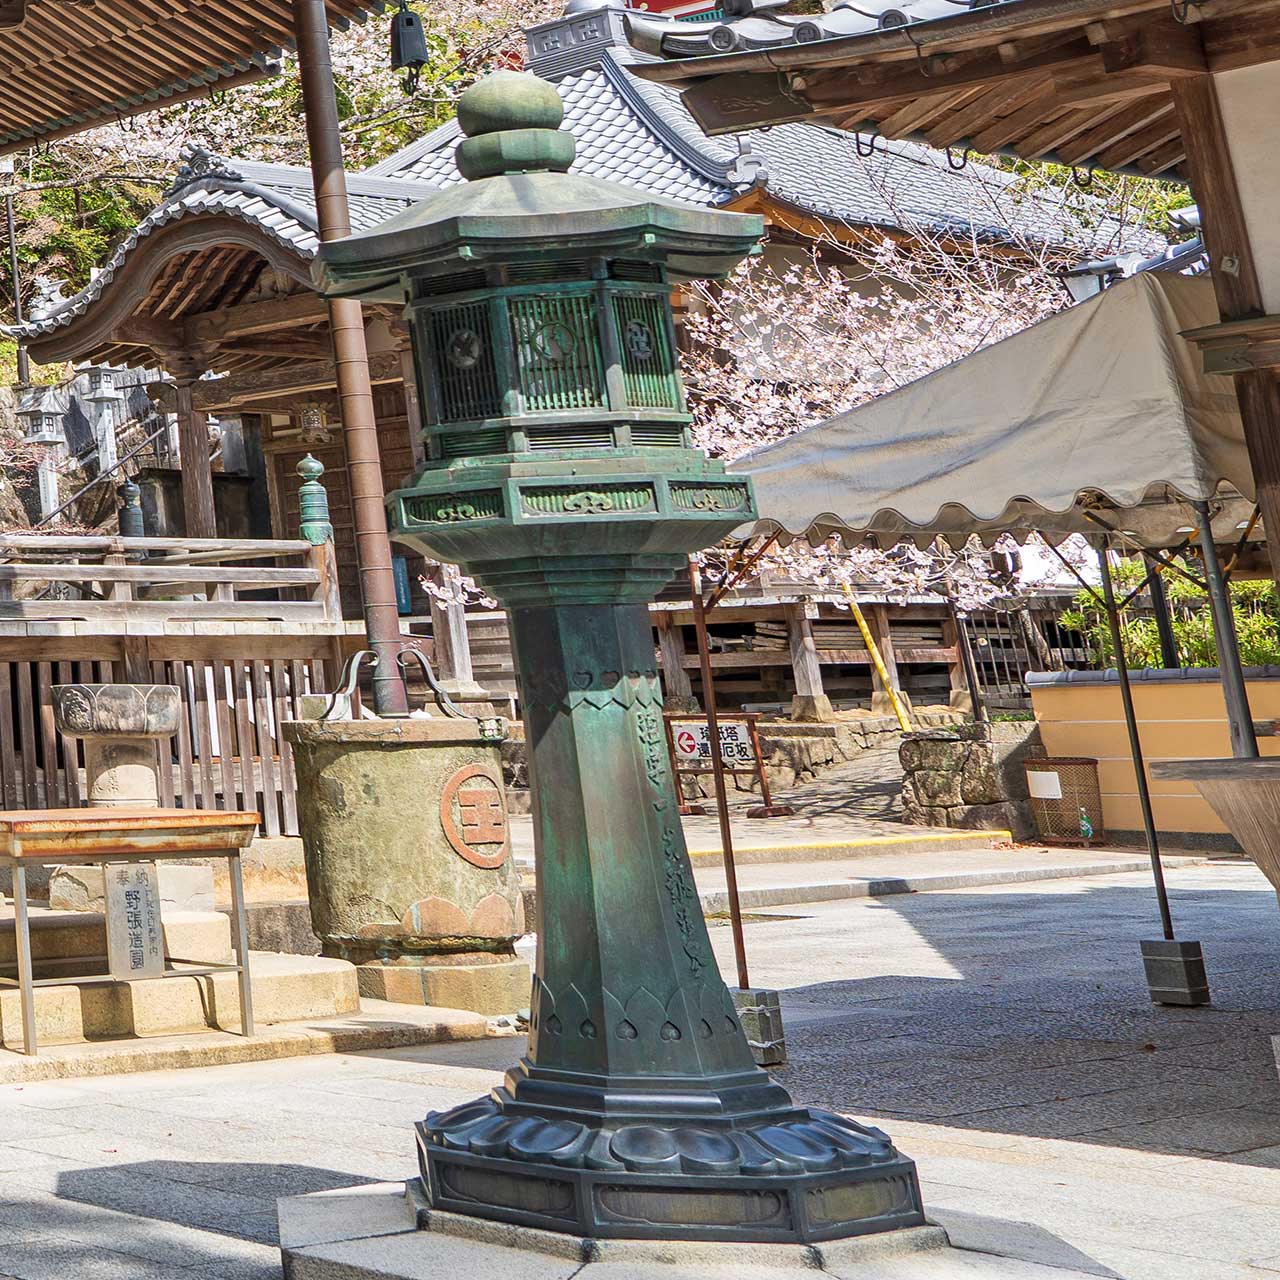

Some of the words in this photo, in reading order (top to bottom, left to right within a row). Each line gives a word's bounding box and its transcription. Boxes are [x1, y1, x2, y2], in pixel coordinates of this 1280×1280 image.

[696, 742, 750, 758] 還厄坂
[125, 889, 145, 970] 野張造園
